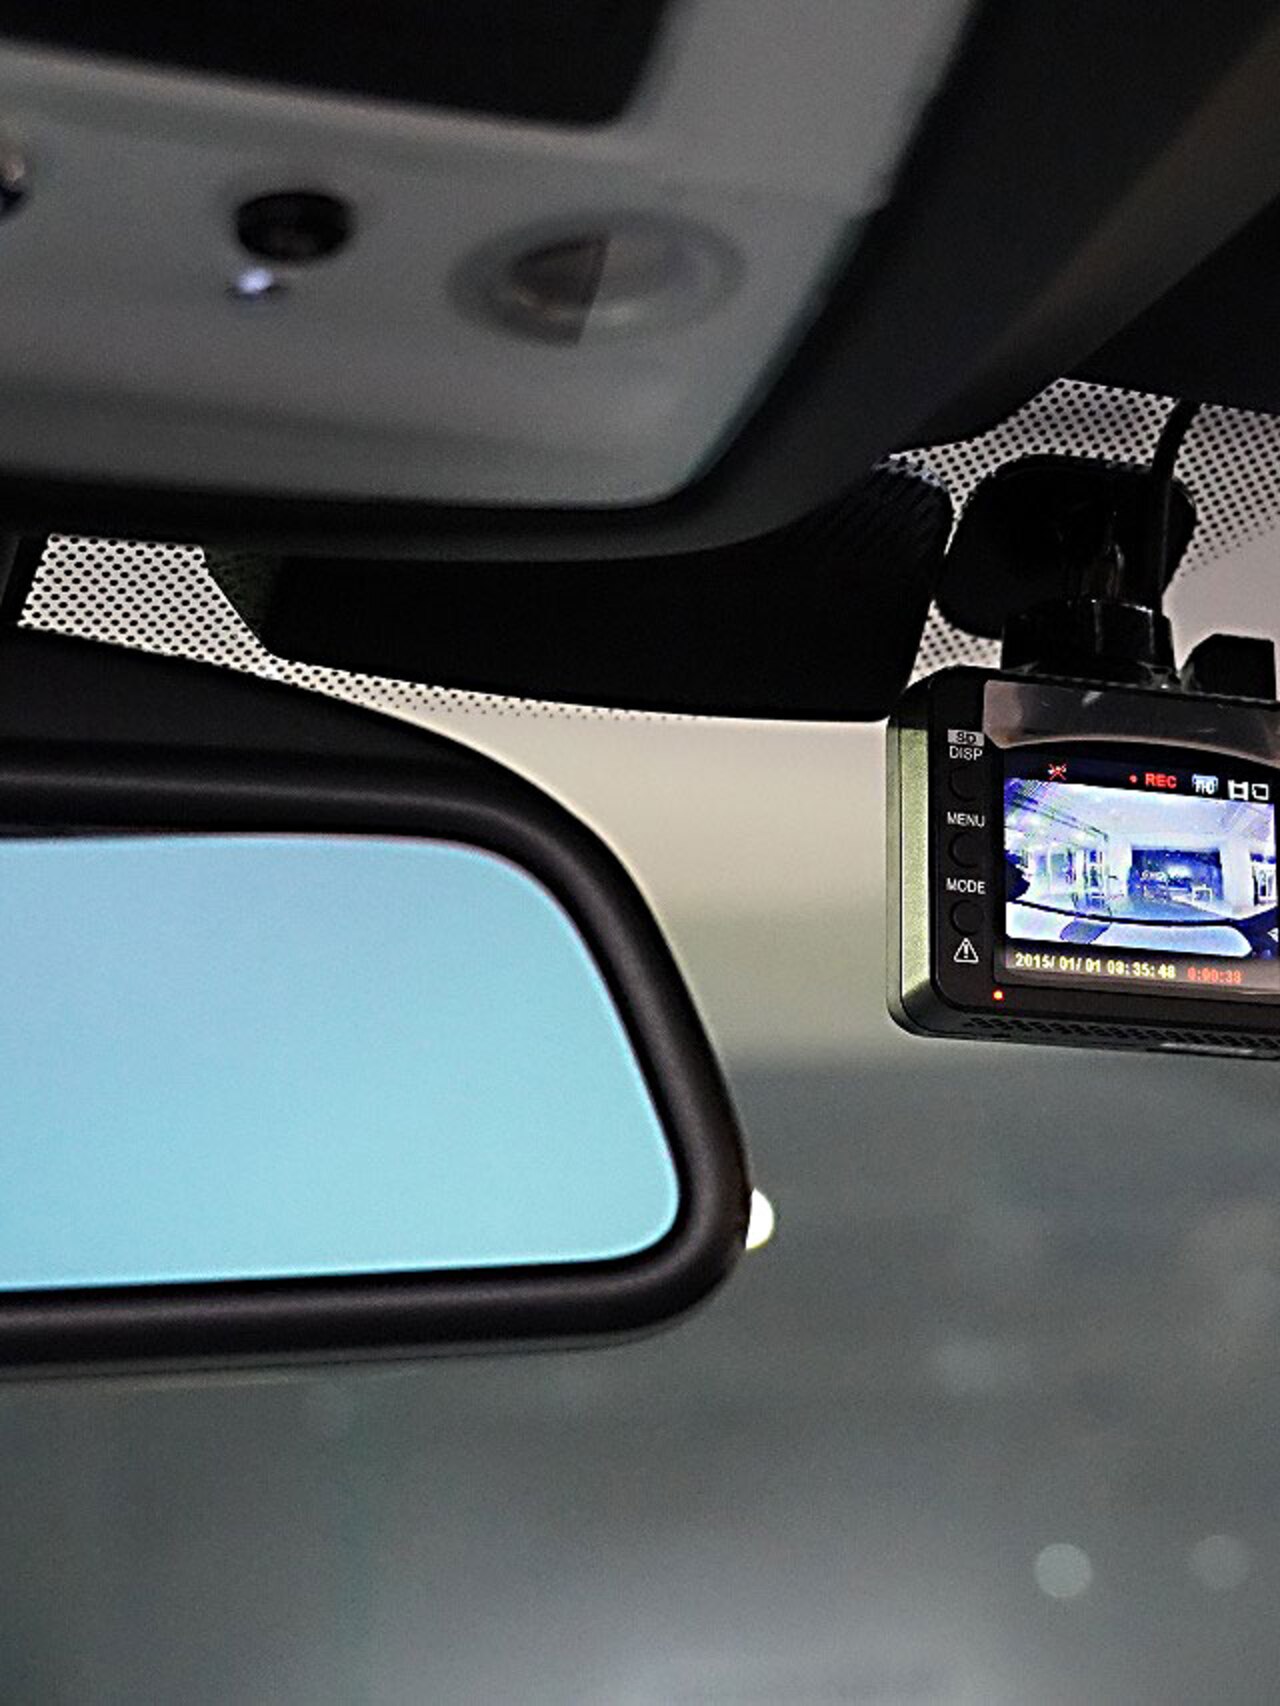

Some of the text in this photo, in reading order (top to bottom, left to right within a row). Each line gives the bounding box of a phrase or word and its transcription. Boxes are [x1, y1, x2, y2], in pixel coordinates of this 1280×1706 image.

[956, 732, 977, 744] SD
[949, 745, 983, 761] DISP
[1145, 772, 1177, 789] REC
[947, 811, 986, 828] MENU
[946, 878, 986, 895] MODE
